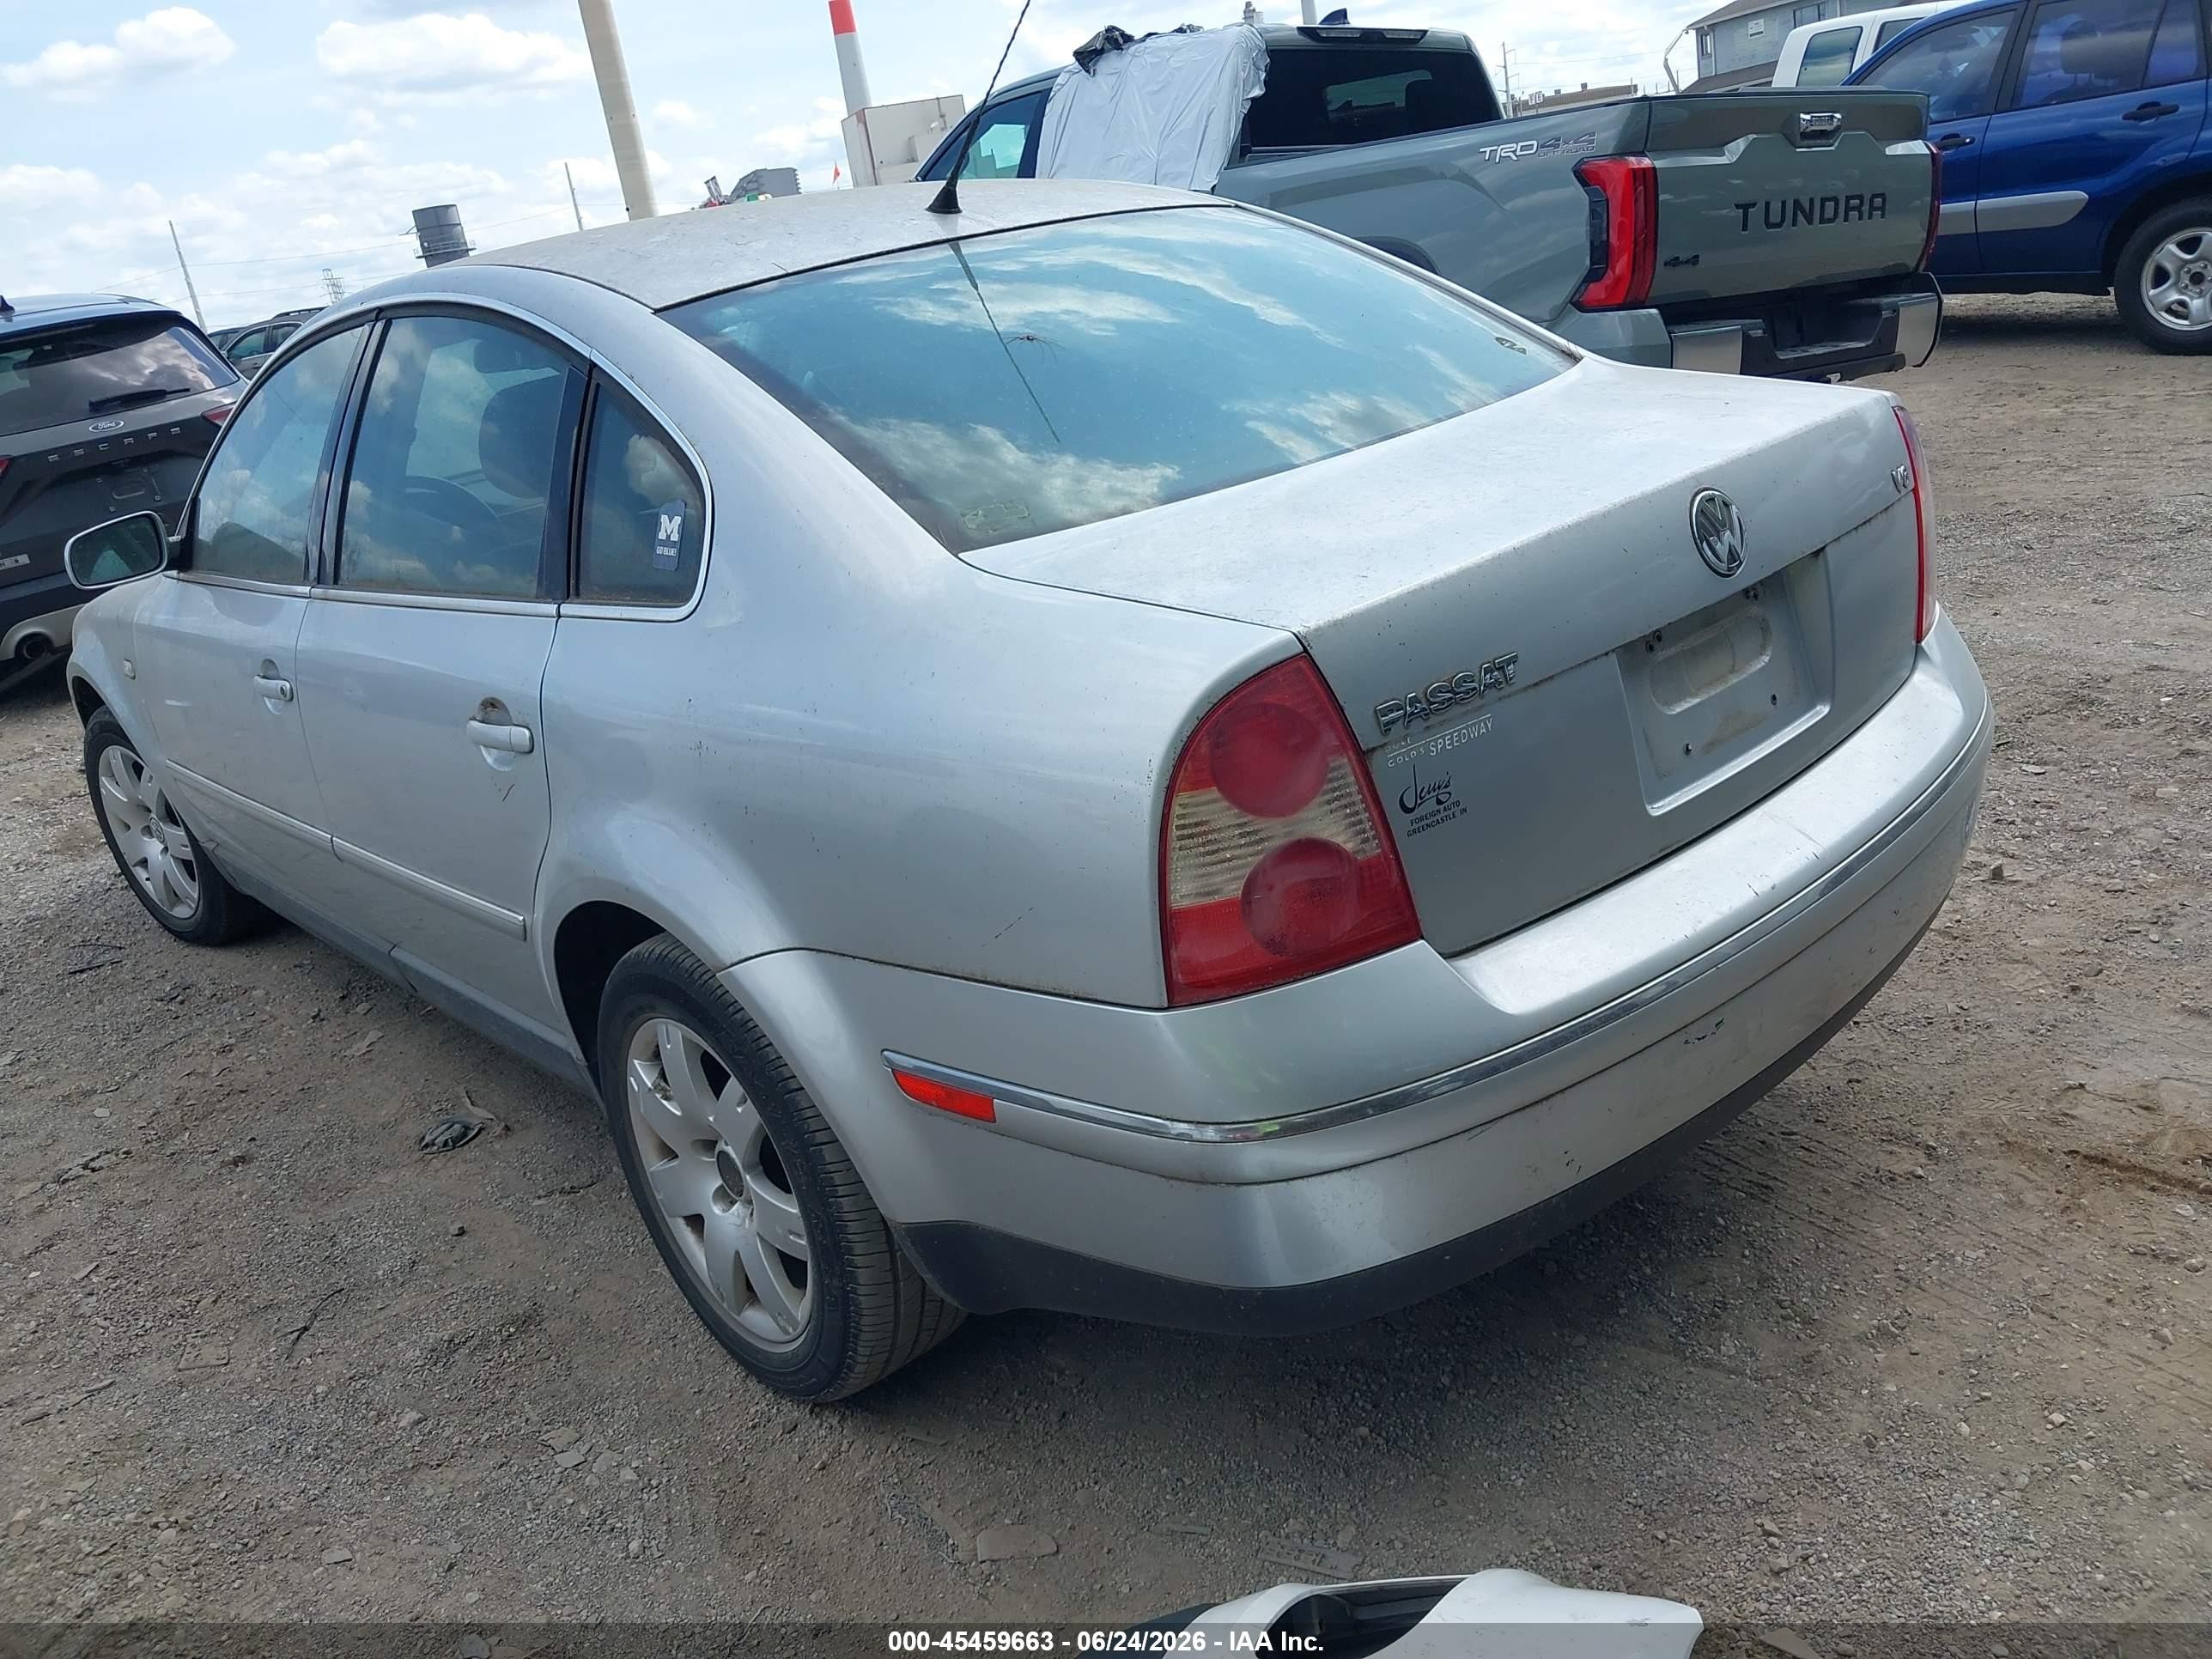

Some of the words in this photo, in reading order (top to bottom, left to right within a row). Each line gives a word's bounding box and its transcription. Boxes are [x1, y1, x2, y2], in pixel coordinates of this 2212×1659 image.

[1479, 140, 1538, 163] TRD
[1734, 192, 1887, 233] TUNDRA
[47, 427, 181, 462] ESCAPE
[1891, 465, 1909, 493] V6
[659, 514, 682, 542] M
[656, 546, 664, 556] GO
[663, 547, 677, 556] BLUE
[1375, 652, 1518, 735] PASSAT
[1429, 718, 1492, 756] SPEEDWAY
[1407, 812, 1457, 837] GREENCASTLE
[1460, 807, 1468, 816] IN
[1410, 808, 1442, 827] FOREIGN
[1443, 799, 1461, 813] AUTO
